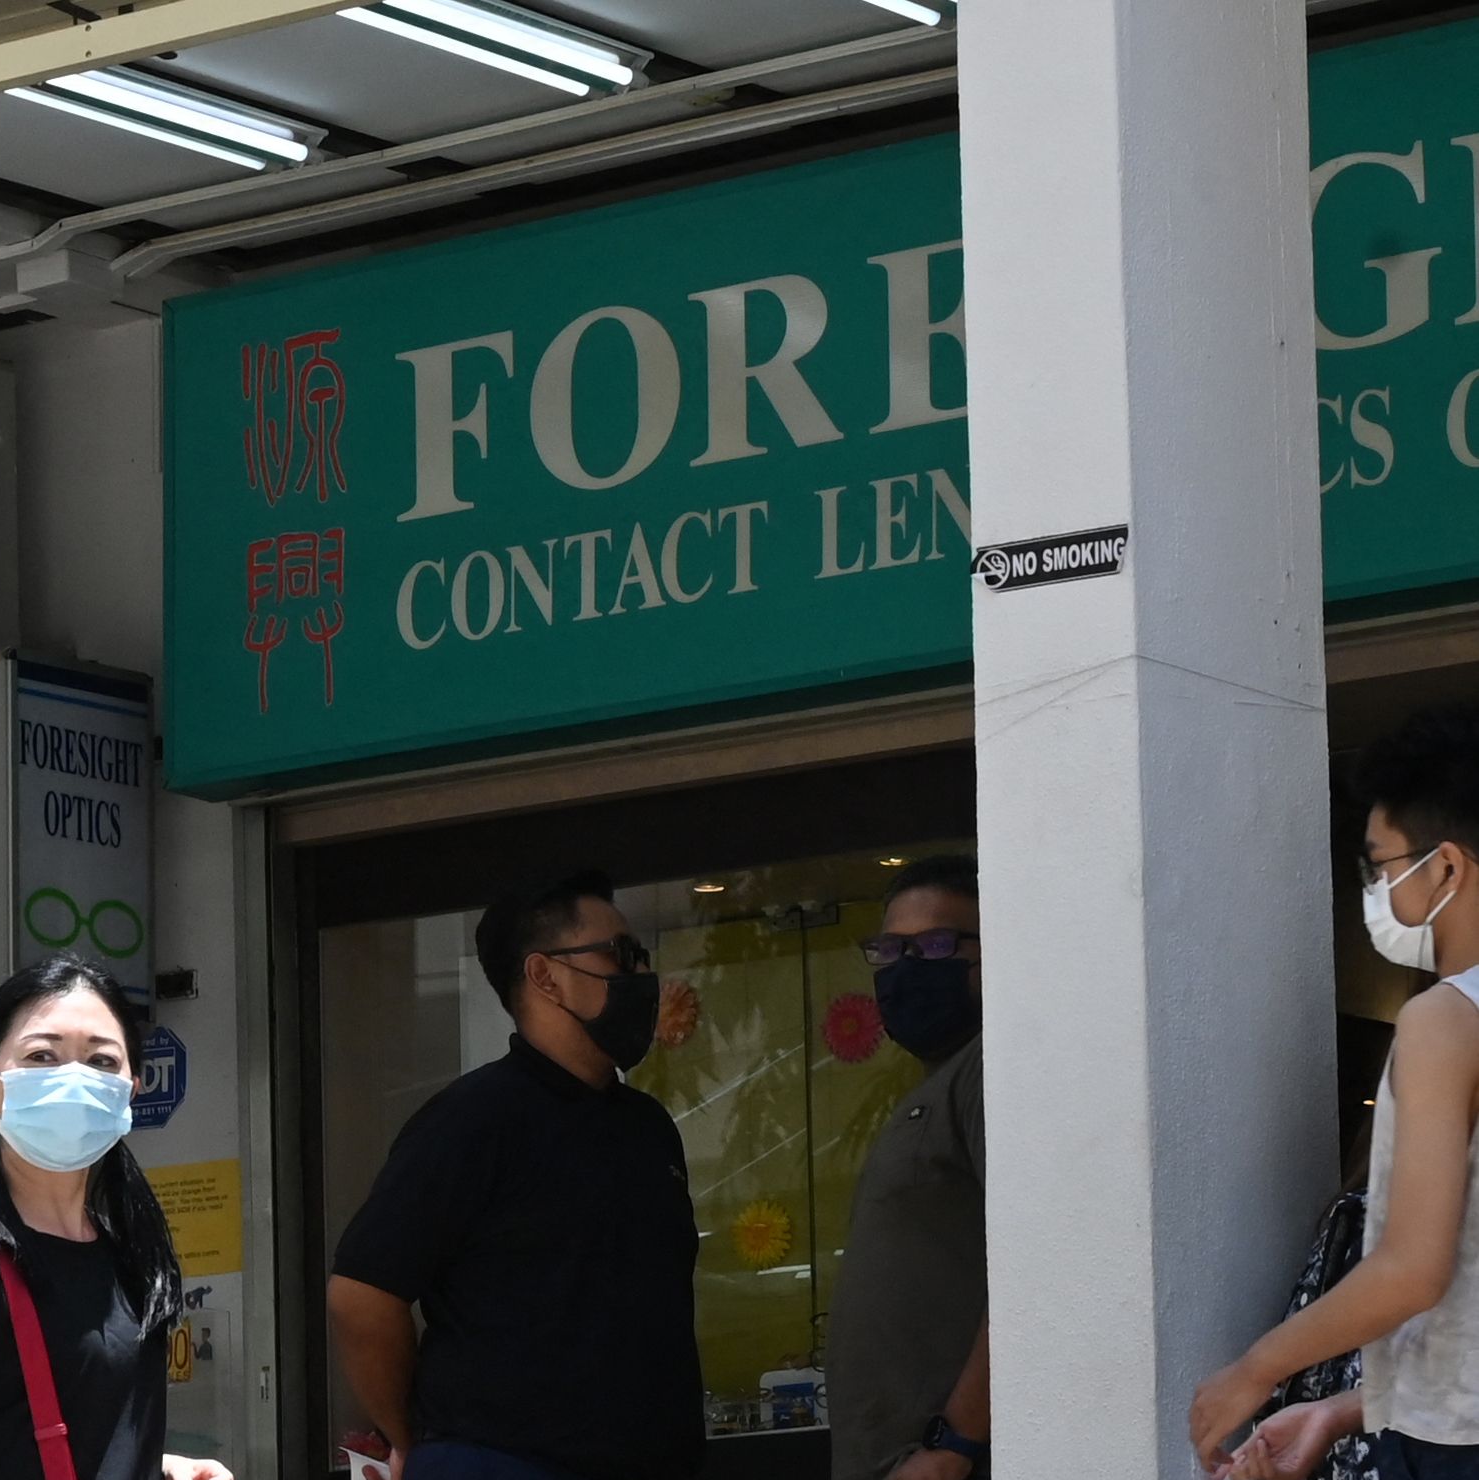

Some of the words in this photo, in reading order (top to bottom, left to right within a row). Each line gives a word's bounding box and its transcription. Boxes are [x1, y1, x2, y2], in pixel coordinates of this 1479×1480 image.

[395, 500, 769, 650] CONTACT
[1011, 551, 1038, 578] NO
[1042, 537, 1126, 573] SMOKING
[18, 719, 143, 788] FORESIGHT
[43, 790, 122, 849] OPTICS
